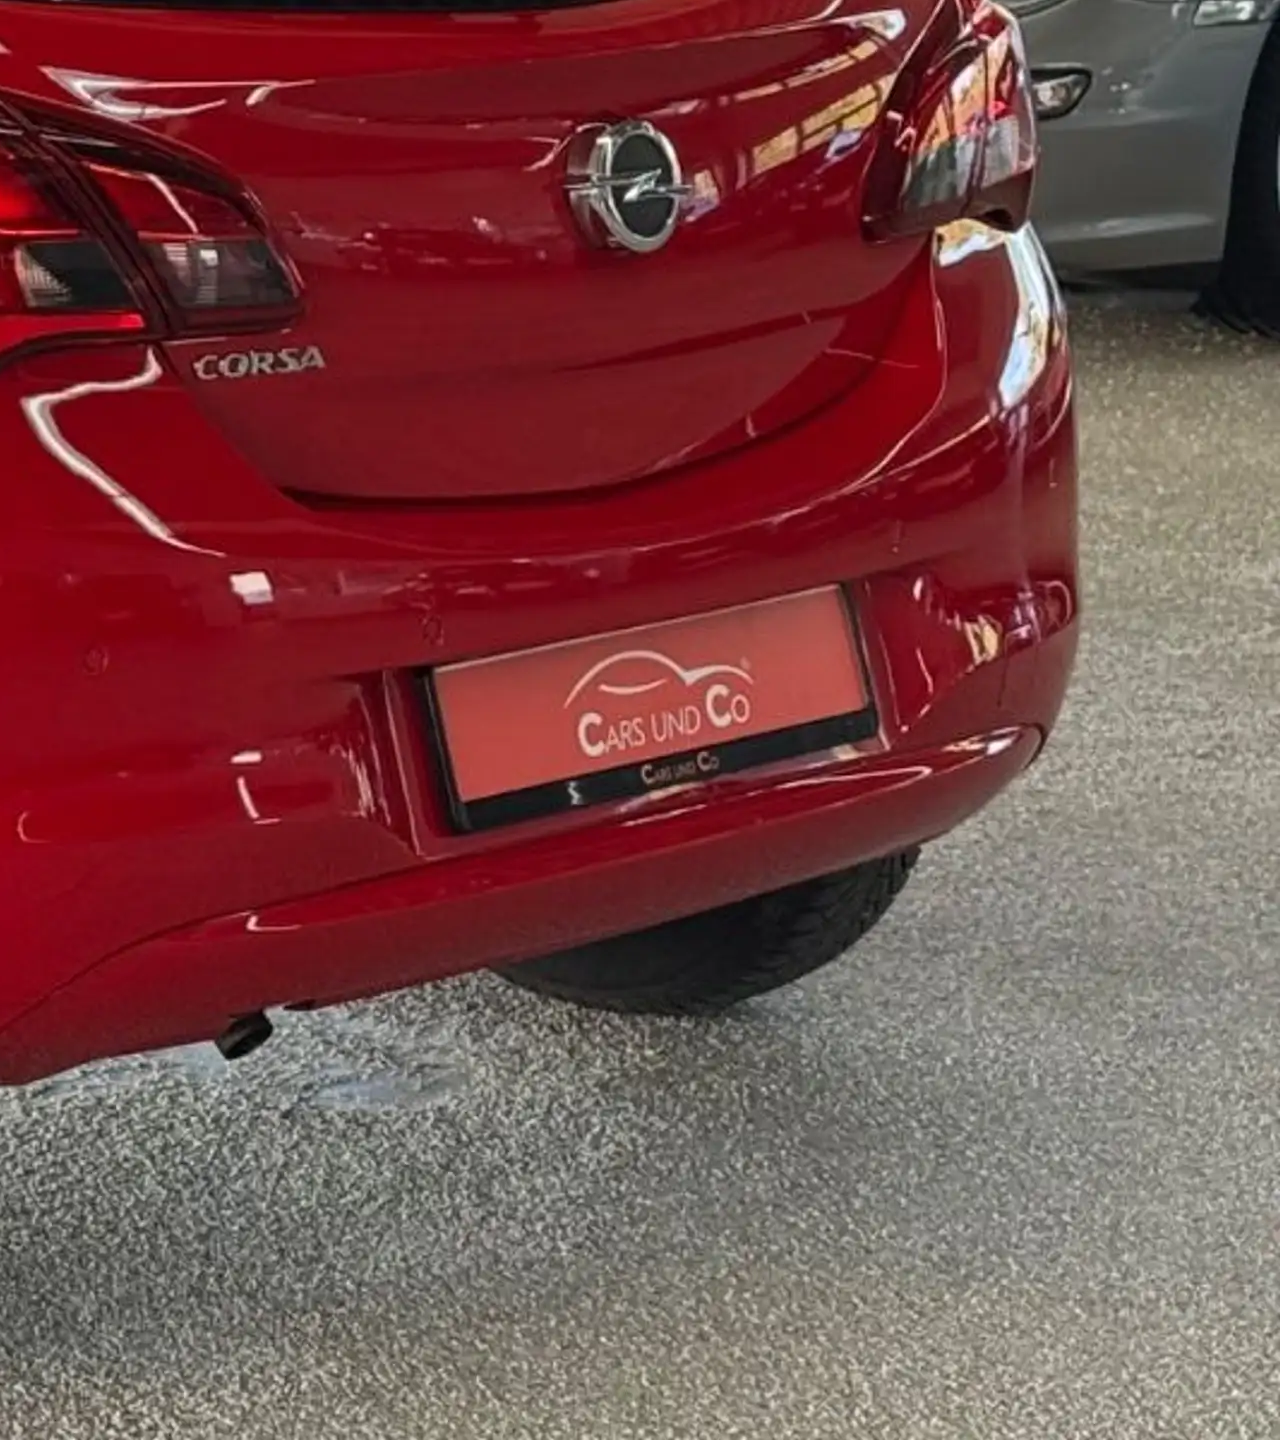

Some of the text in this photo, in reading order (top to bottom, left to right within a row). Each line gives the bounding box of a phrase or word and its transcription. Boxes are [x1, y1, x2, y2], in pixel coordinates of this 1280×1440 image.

[193, 346, 326, 380] CORSA
[577, 711, 647, 757] CARS
[650, 706, 702, 743] UND
